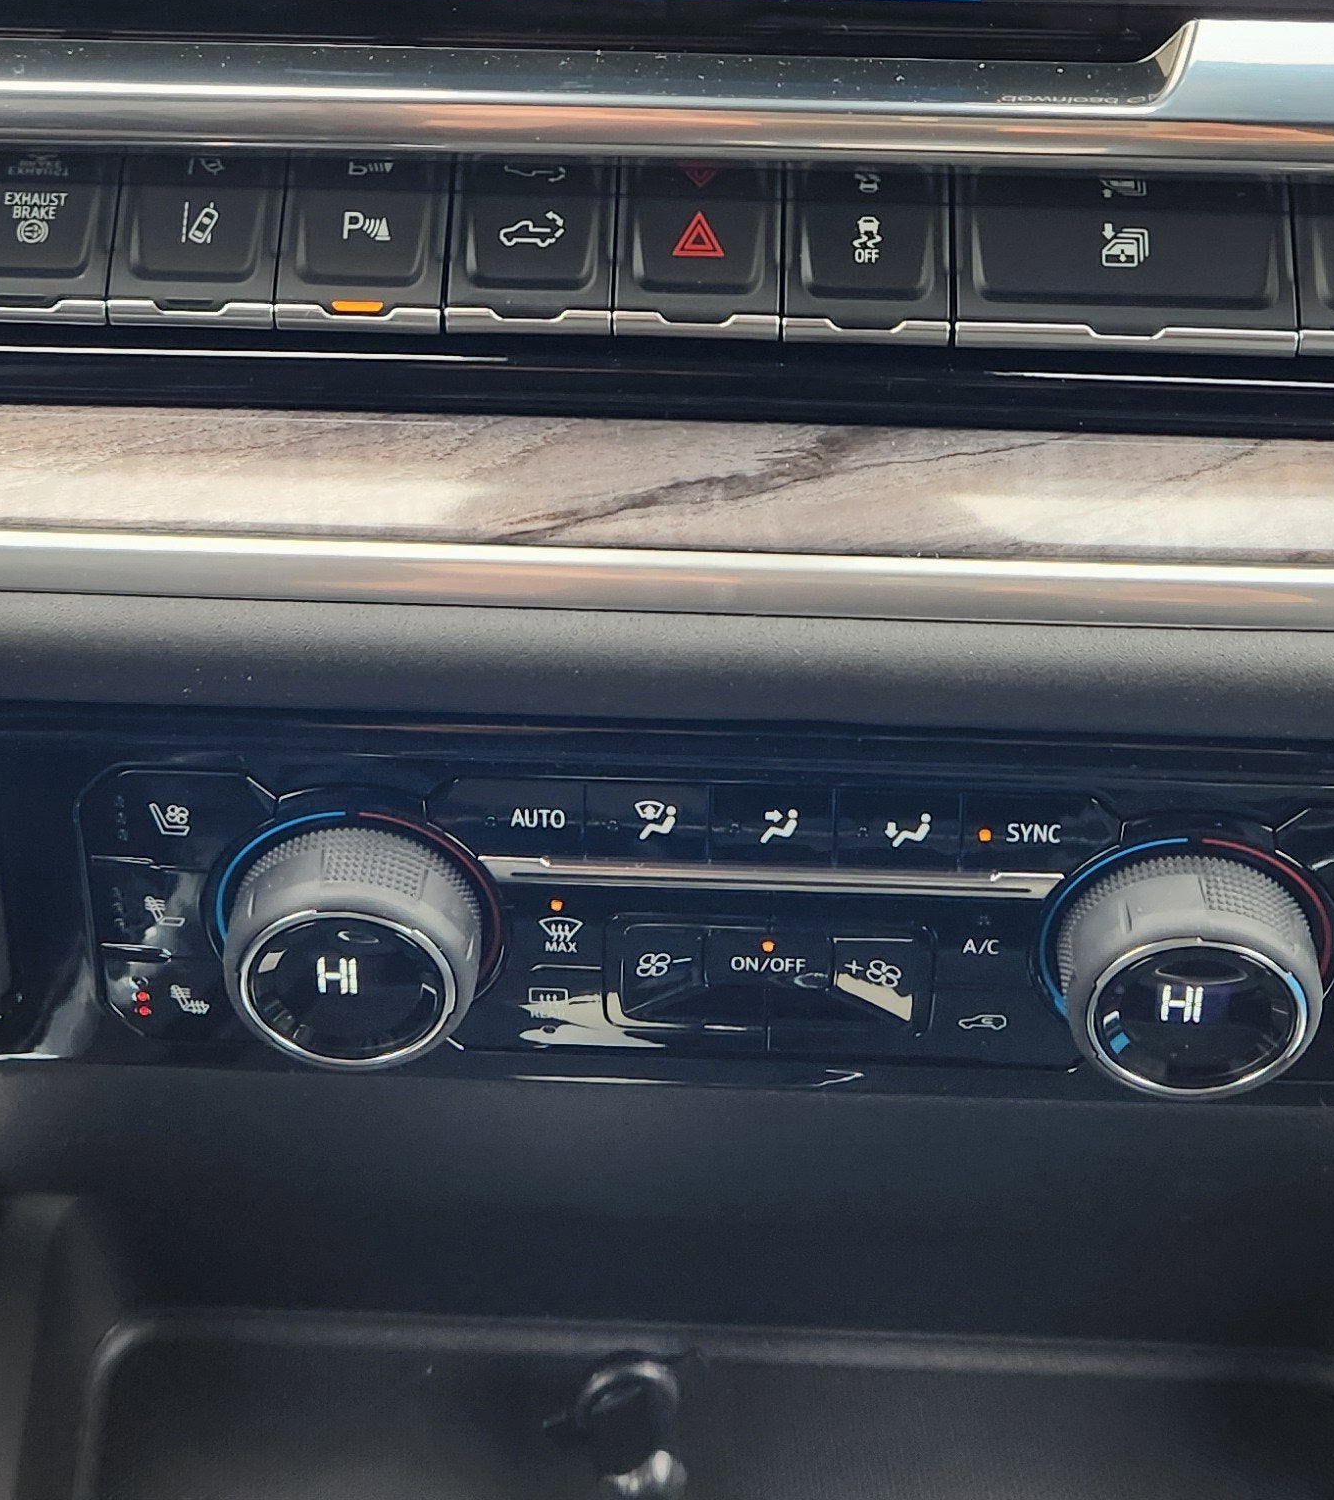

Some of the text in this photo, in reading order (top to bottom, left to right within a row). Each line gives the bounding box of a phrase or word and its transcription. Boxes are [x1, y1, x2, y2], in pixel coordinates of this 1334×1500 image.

[4, 192, 67, 207] EXHAUST
[12, 205, 56, 219] BRAKE
[853, 248, 880, 264] OFF
[510, 808, 566, 830] AUTO
[1005, 822, 1061, 845] SYNC
[545, 941, 577, 953] MAX
[962, 937, 999, 957] A/C
[730, 956, 806, 973] ON/OFF
[315, 956, 359, 995] HI
[1160, 985, 1203, 1024] HI
